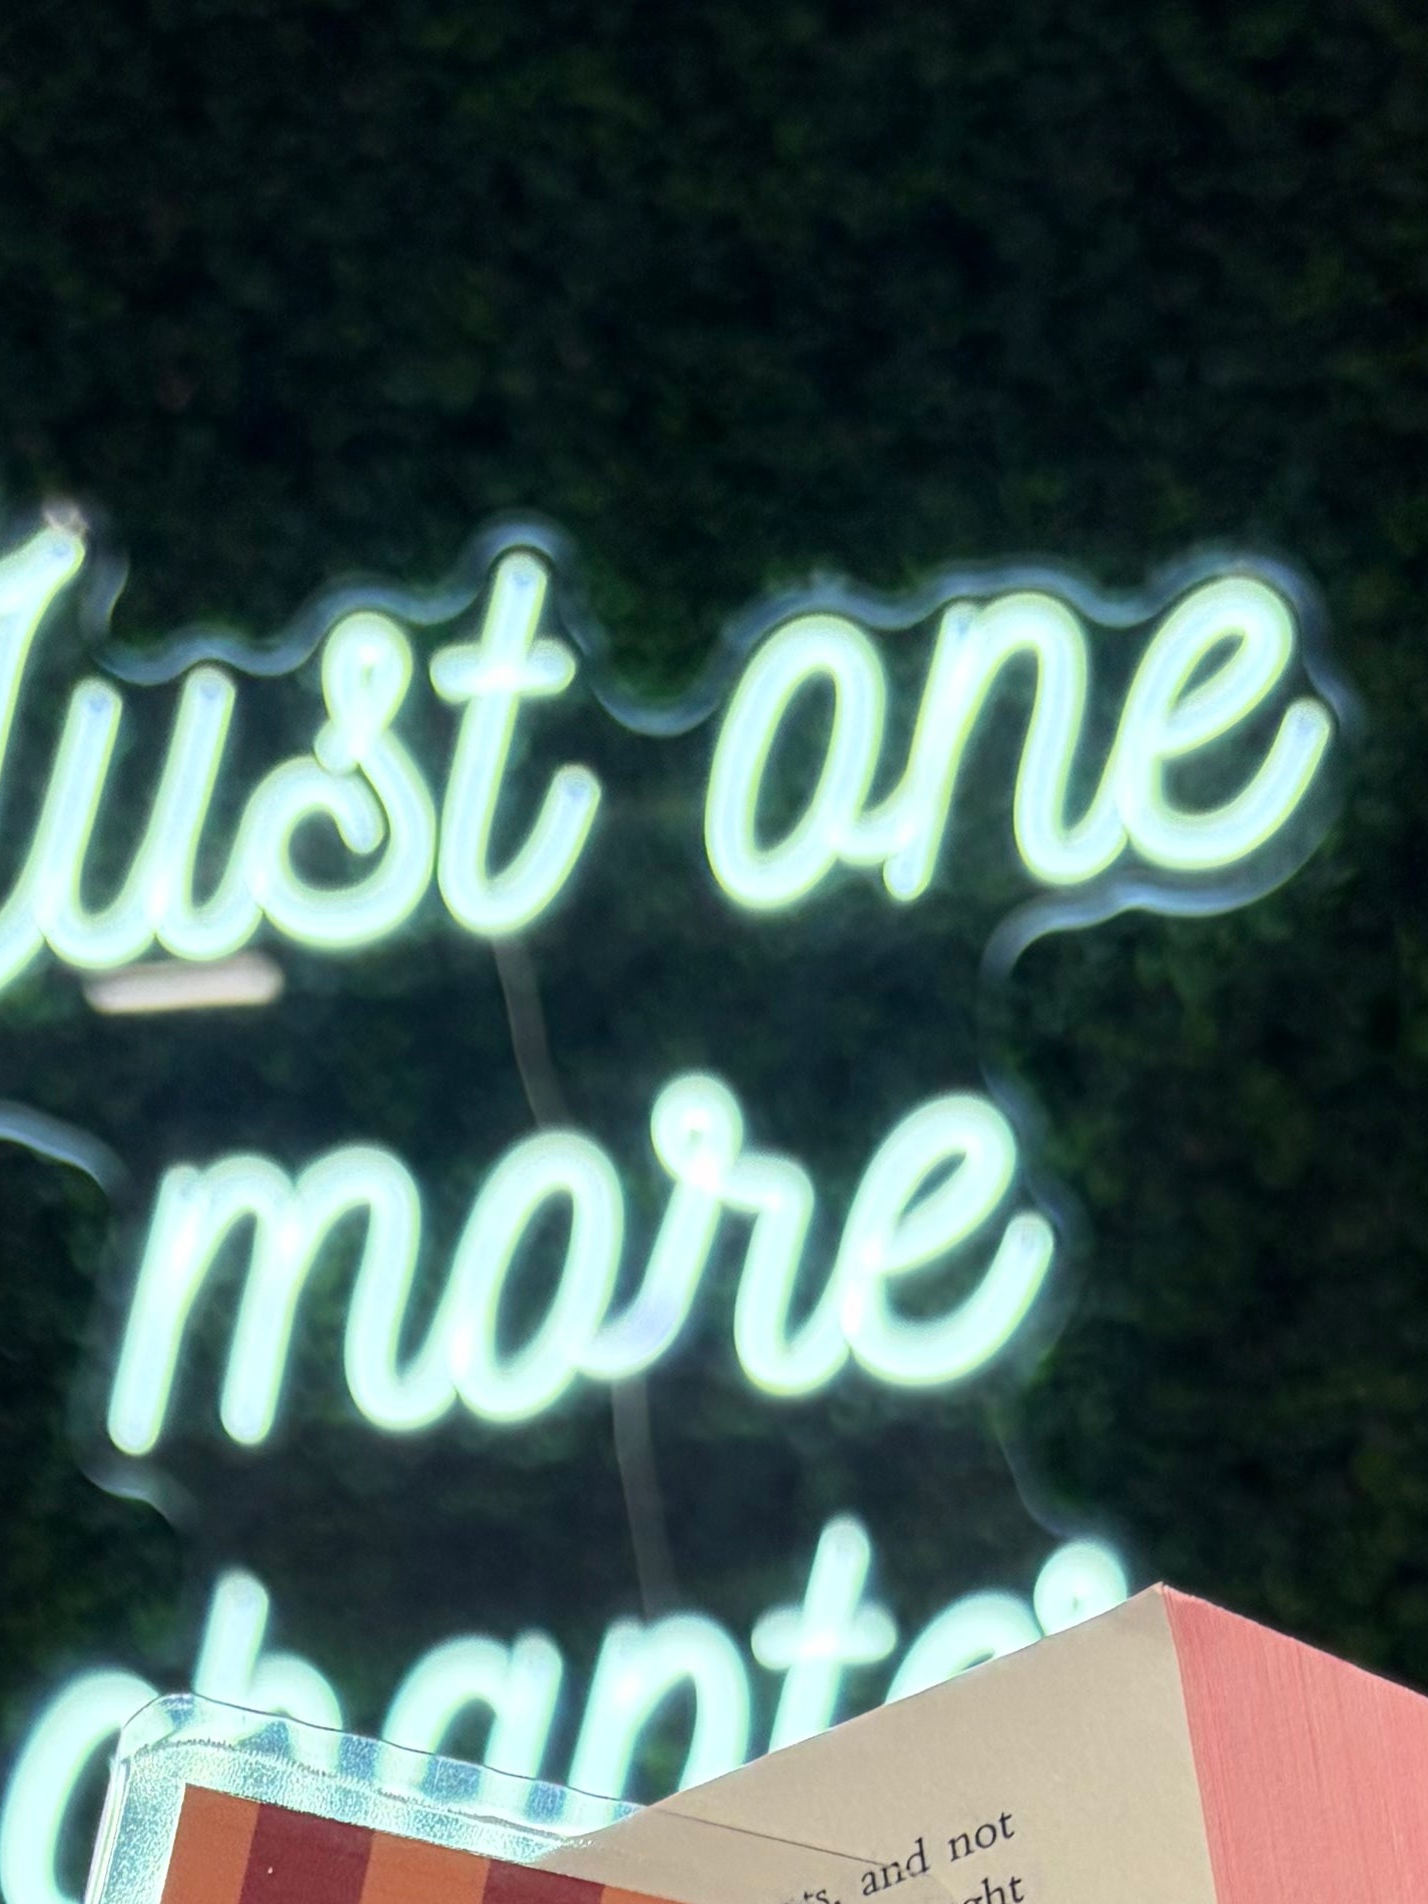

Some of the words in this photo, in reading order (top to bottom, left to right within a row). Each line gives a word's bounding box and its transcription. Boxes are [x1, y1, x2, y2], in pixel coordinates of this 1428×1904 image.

[705, 575, 1330, 908] one
[108, 1072, 1053, 1455] more
[861, 1836, 930, 1897] and
[947, 1811, 1015, 1862] not
